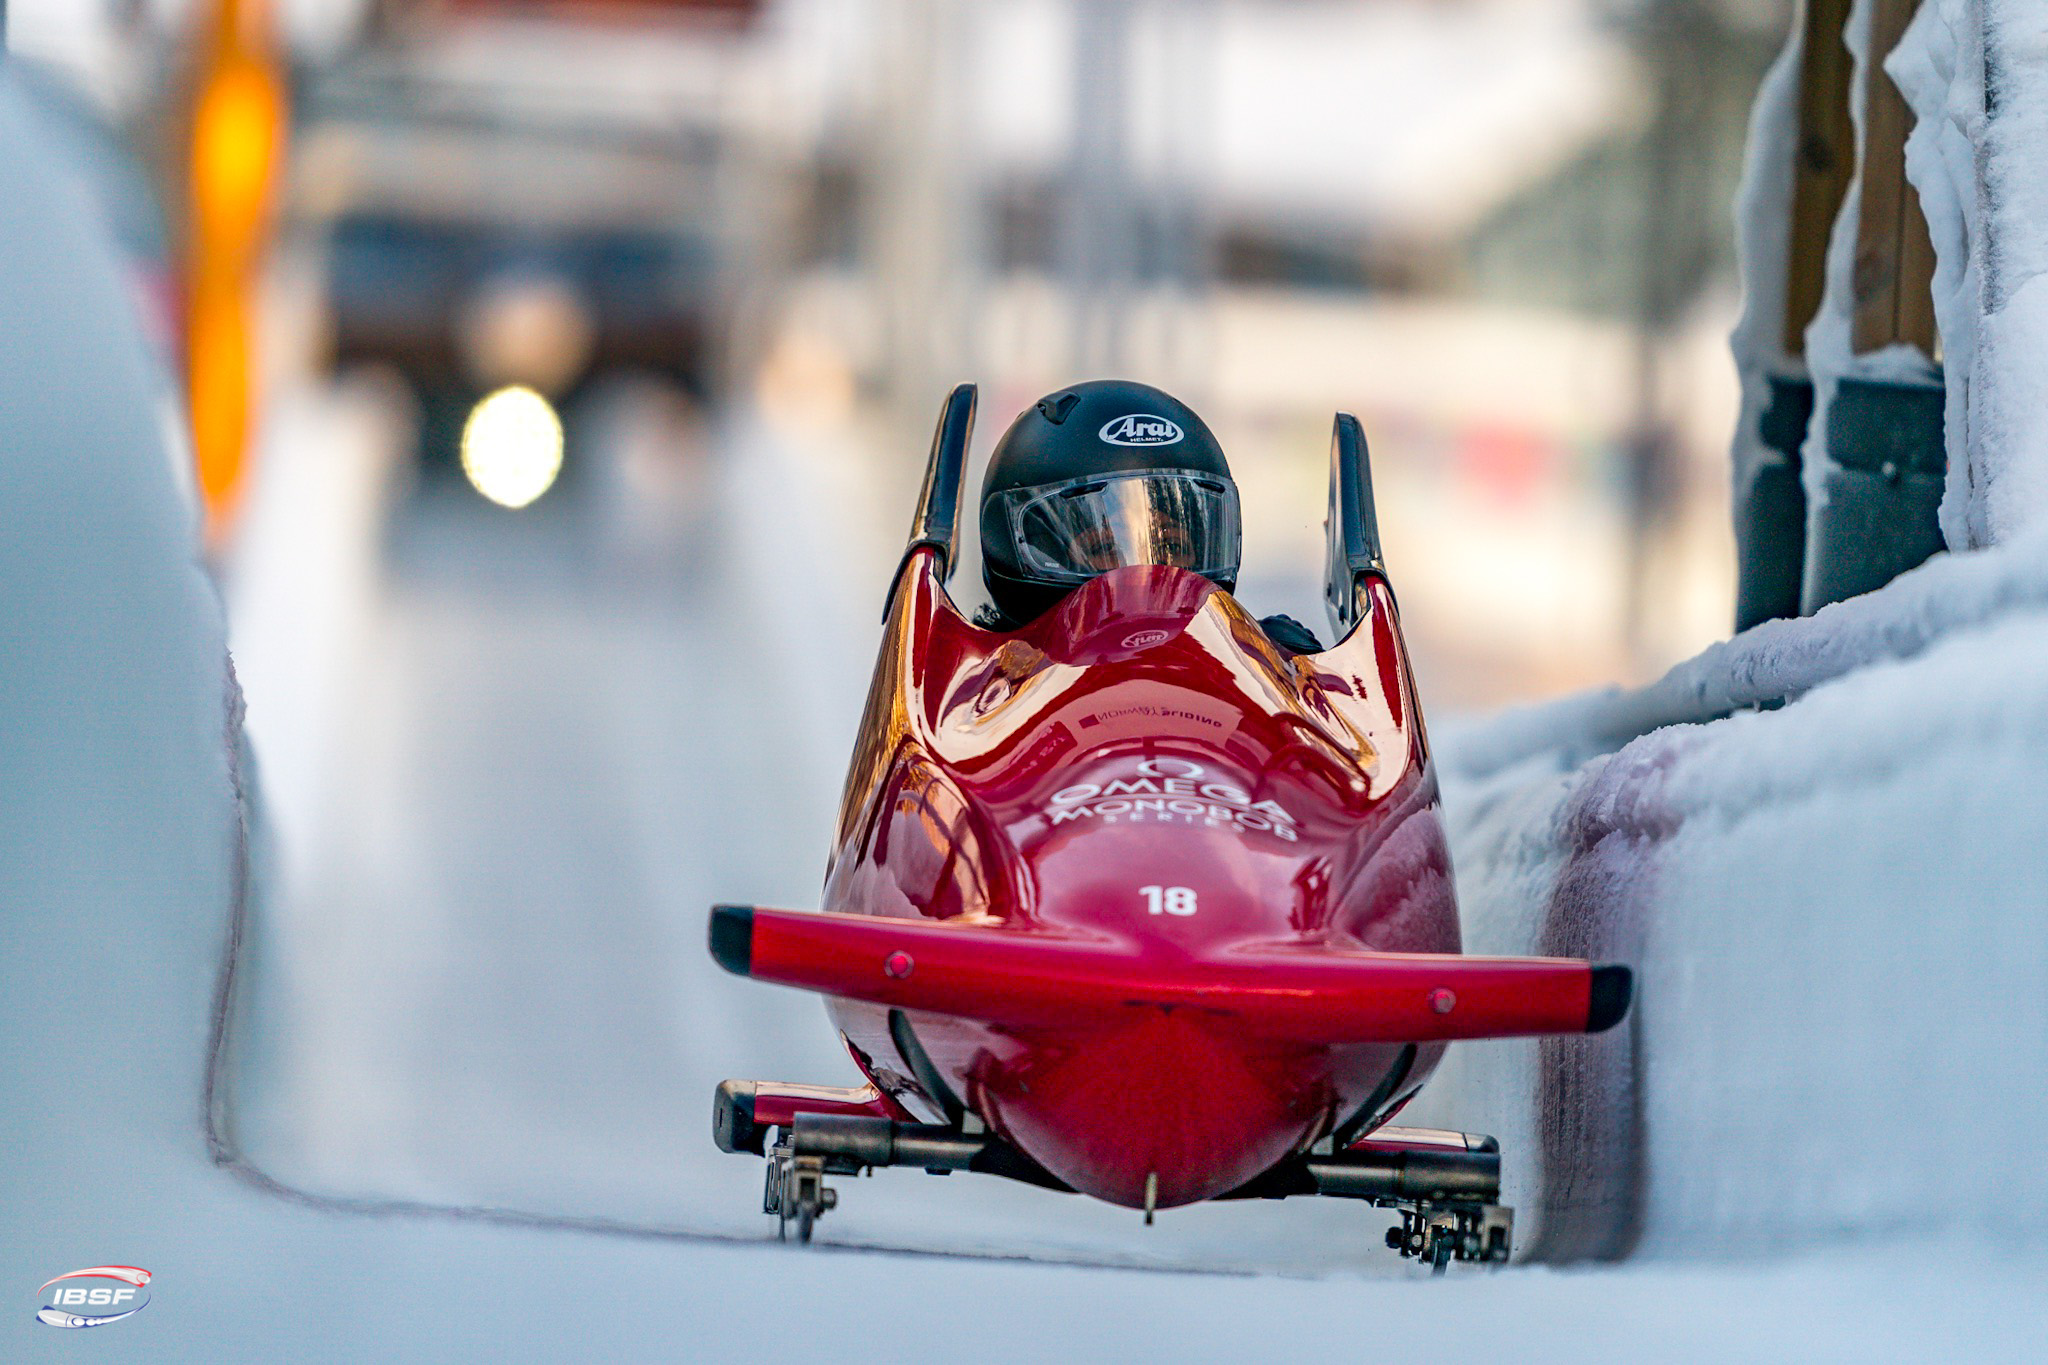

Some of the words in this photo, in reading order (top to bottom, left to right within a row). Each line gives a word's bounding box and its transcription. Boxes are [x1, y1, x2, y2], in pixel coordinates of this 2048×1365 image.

[1106, 417, 1175, 440] Arai
[1050, 777, 1296, 826] OMEGA
[1051, 799, 1299, 842] MONOBOB
[1103, 811, 1246, 834] SERIES
[1138, 885, 1198, 917] 18
